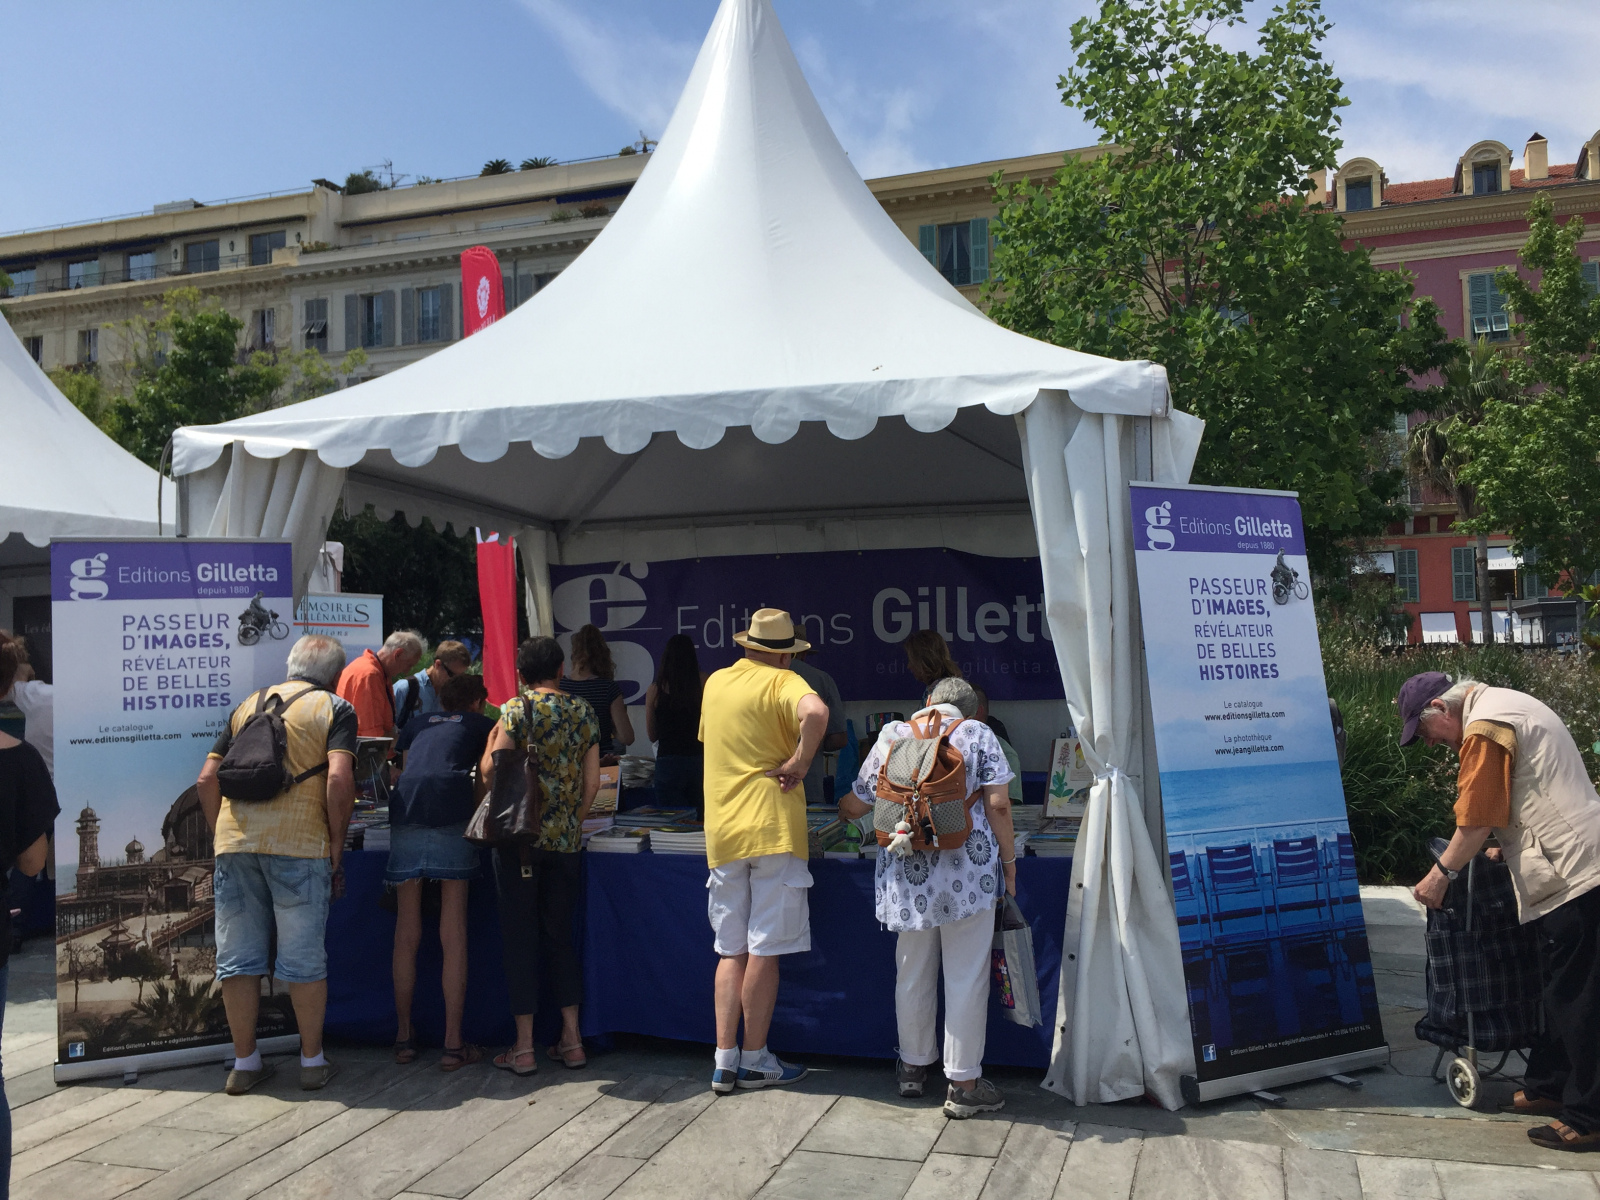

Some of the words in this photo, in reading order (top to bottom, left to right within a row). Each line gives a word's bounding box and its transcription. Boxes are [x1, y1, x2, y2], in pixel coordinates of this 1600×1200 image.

[1180, 516, 1232, 536] Editions
[1234, 515, 1292, 539] Gilletta
[1237, 541, 1259, 550] depuis
[1260, 541, 1275, 549] 1880
[118, 567, 191, 584] Editions
[197, 562, 278, 583] Gilletta
[197, 585, 228, 596] depuis
[230, 586, 250, 595] 1880
[1189, 577, 1267, 596] PASSEUR
[1192, 599, 1271, 618] D'IMAGES,
[122, 614, 230, 632] PASSEUR
[677, 602, 854, 649] Editns
[872, 587, 1053, 643] Gillett
[1194, 620, 1273, 638] RÉVÉLATEUR
[122, 632, 231, 651] D'IMAGES,
[1197, 643, 1215, 659] DE
[1222, 642, 1276, 659] BELLES
[122, 654, 231, 673] RÉVÉLATEUR
[1200, 663, 1279, 681] HISTOIRES
[123, 676, 148, 692] DE
[157, 673, 231, 690] BELLES
[123, 692, 231, 712] HISTOIRES
[1224, 701, 1232, 709] Le
[1233, 700, 1263, 710] catalogue
[206, 719, 216, 728] La
[1204, 710, 1286, 721] www.editionsgilletta.com
[99, 725, 110, 733] Le
[113, 723, 154, 734] catalogue
[70, 731, 182, 745] www.editionsgilletta.com
[1224, 734, 1232, 743] La
[1233, 733, 1272, 744] photothèque
[1214, 743, 1285, 756] www.jeangilletta.com
[102, 1045, 125, 1053] Editions
